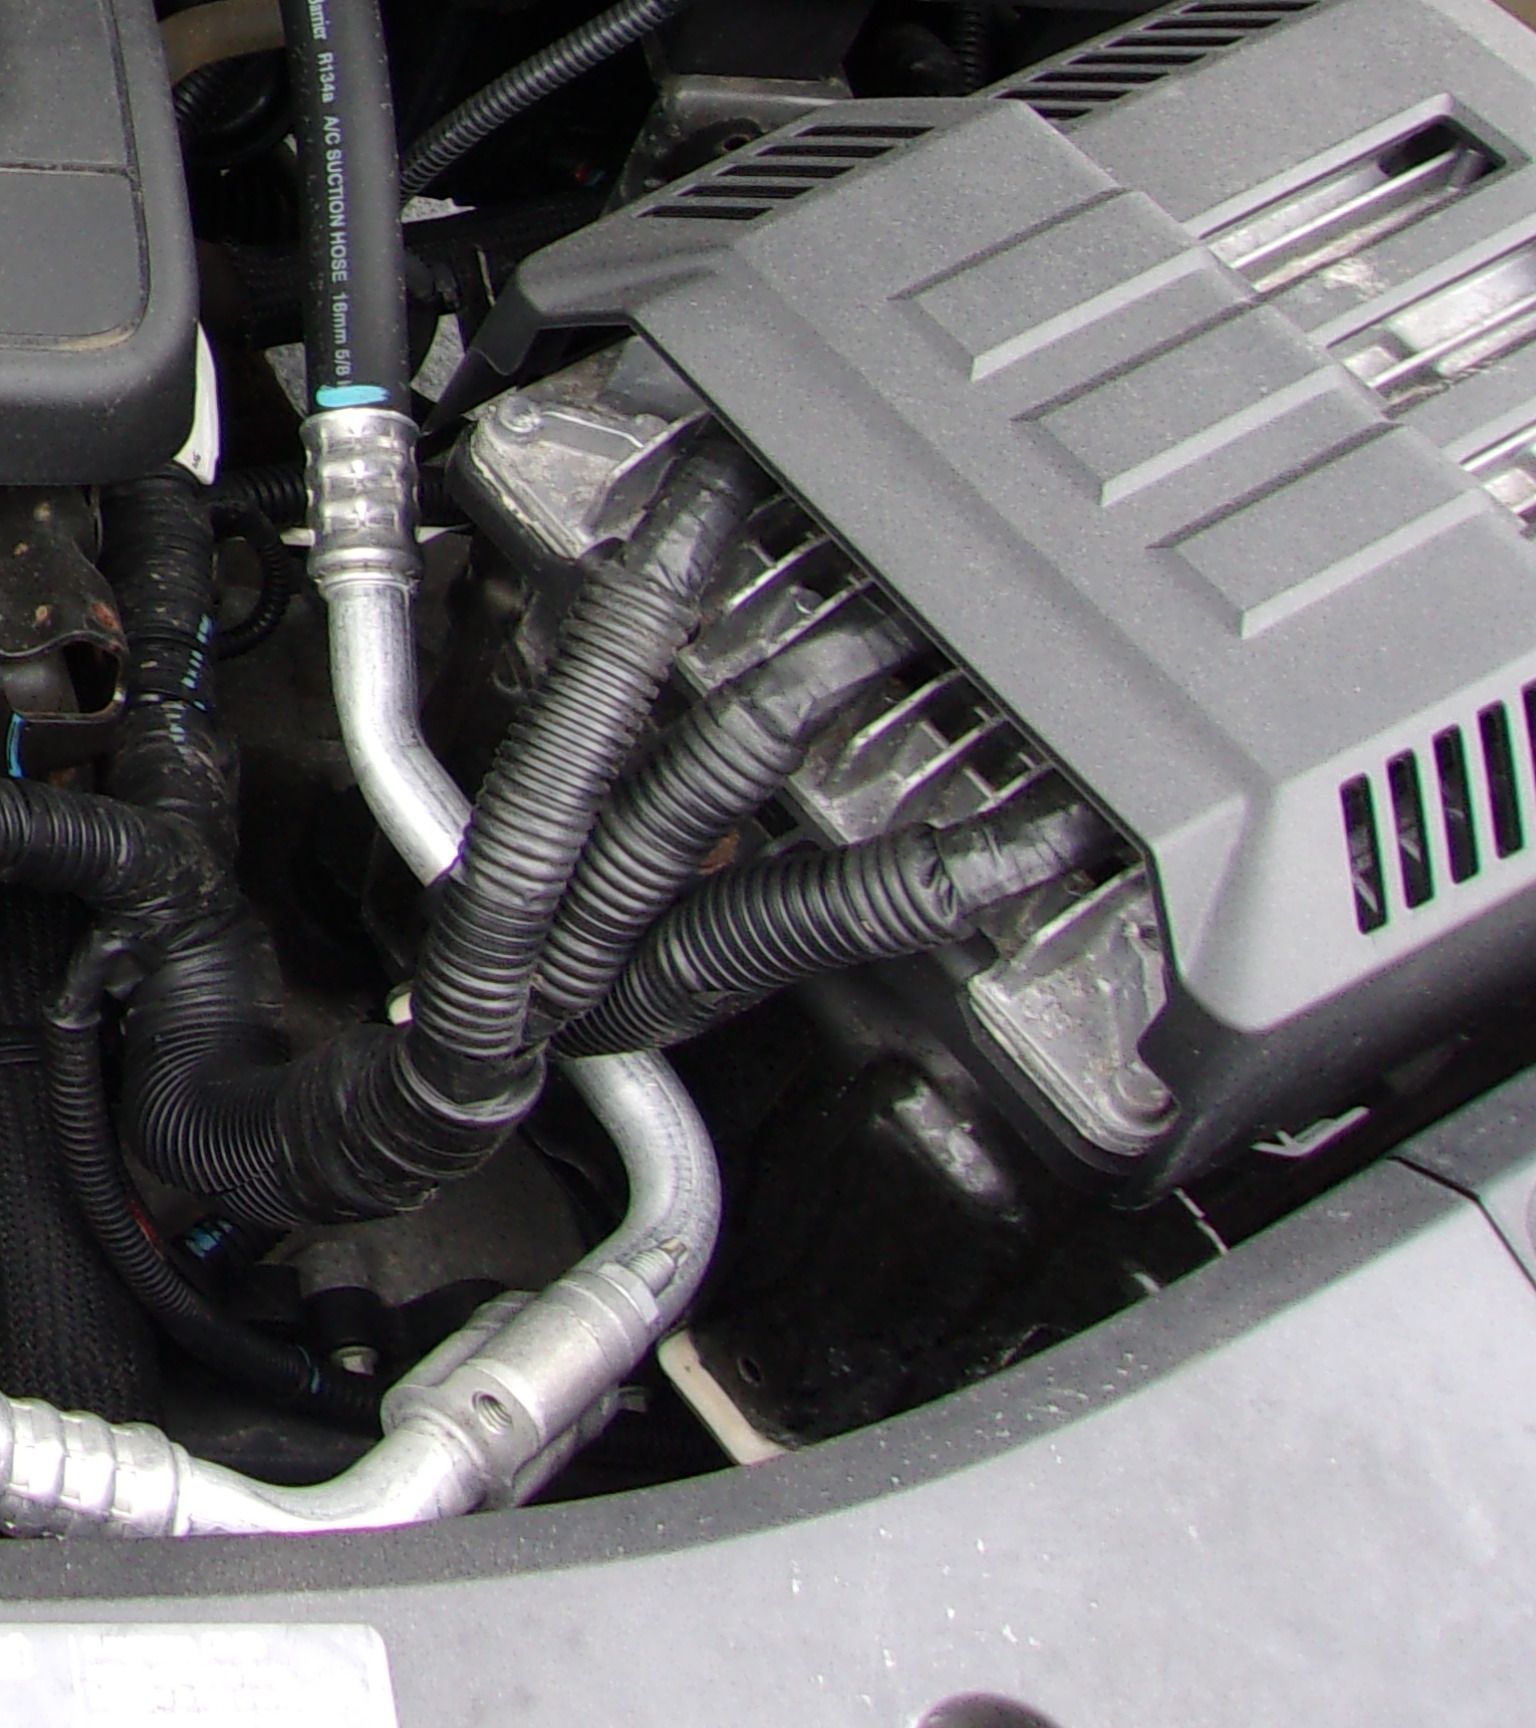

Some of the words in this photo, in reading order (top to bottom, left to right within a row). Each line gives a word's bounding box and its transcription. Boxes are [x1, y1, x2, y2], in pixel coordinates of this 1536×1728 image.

[316, 51, 336, 104] R134a
[322, 115, 342, 146] A/C
[325, 146, 346, 229] SUCTION
[329, 231, 348, 283] HOSE
[332, 292, 349, 346] 16mm
[334, 348, 353, 376] 5/8
